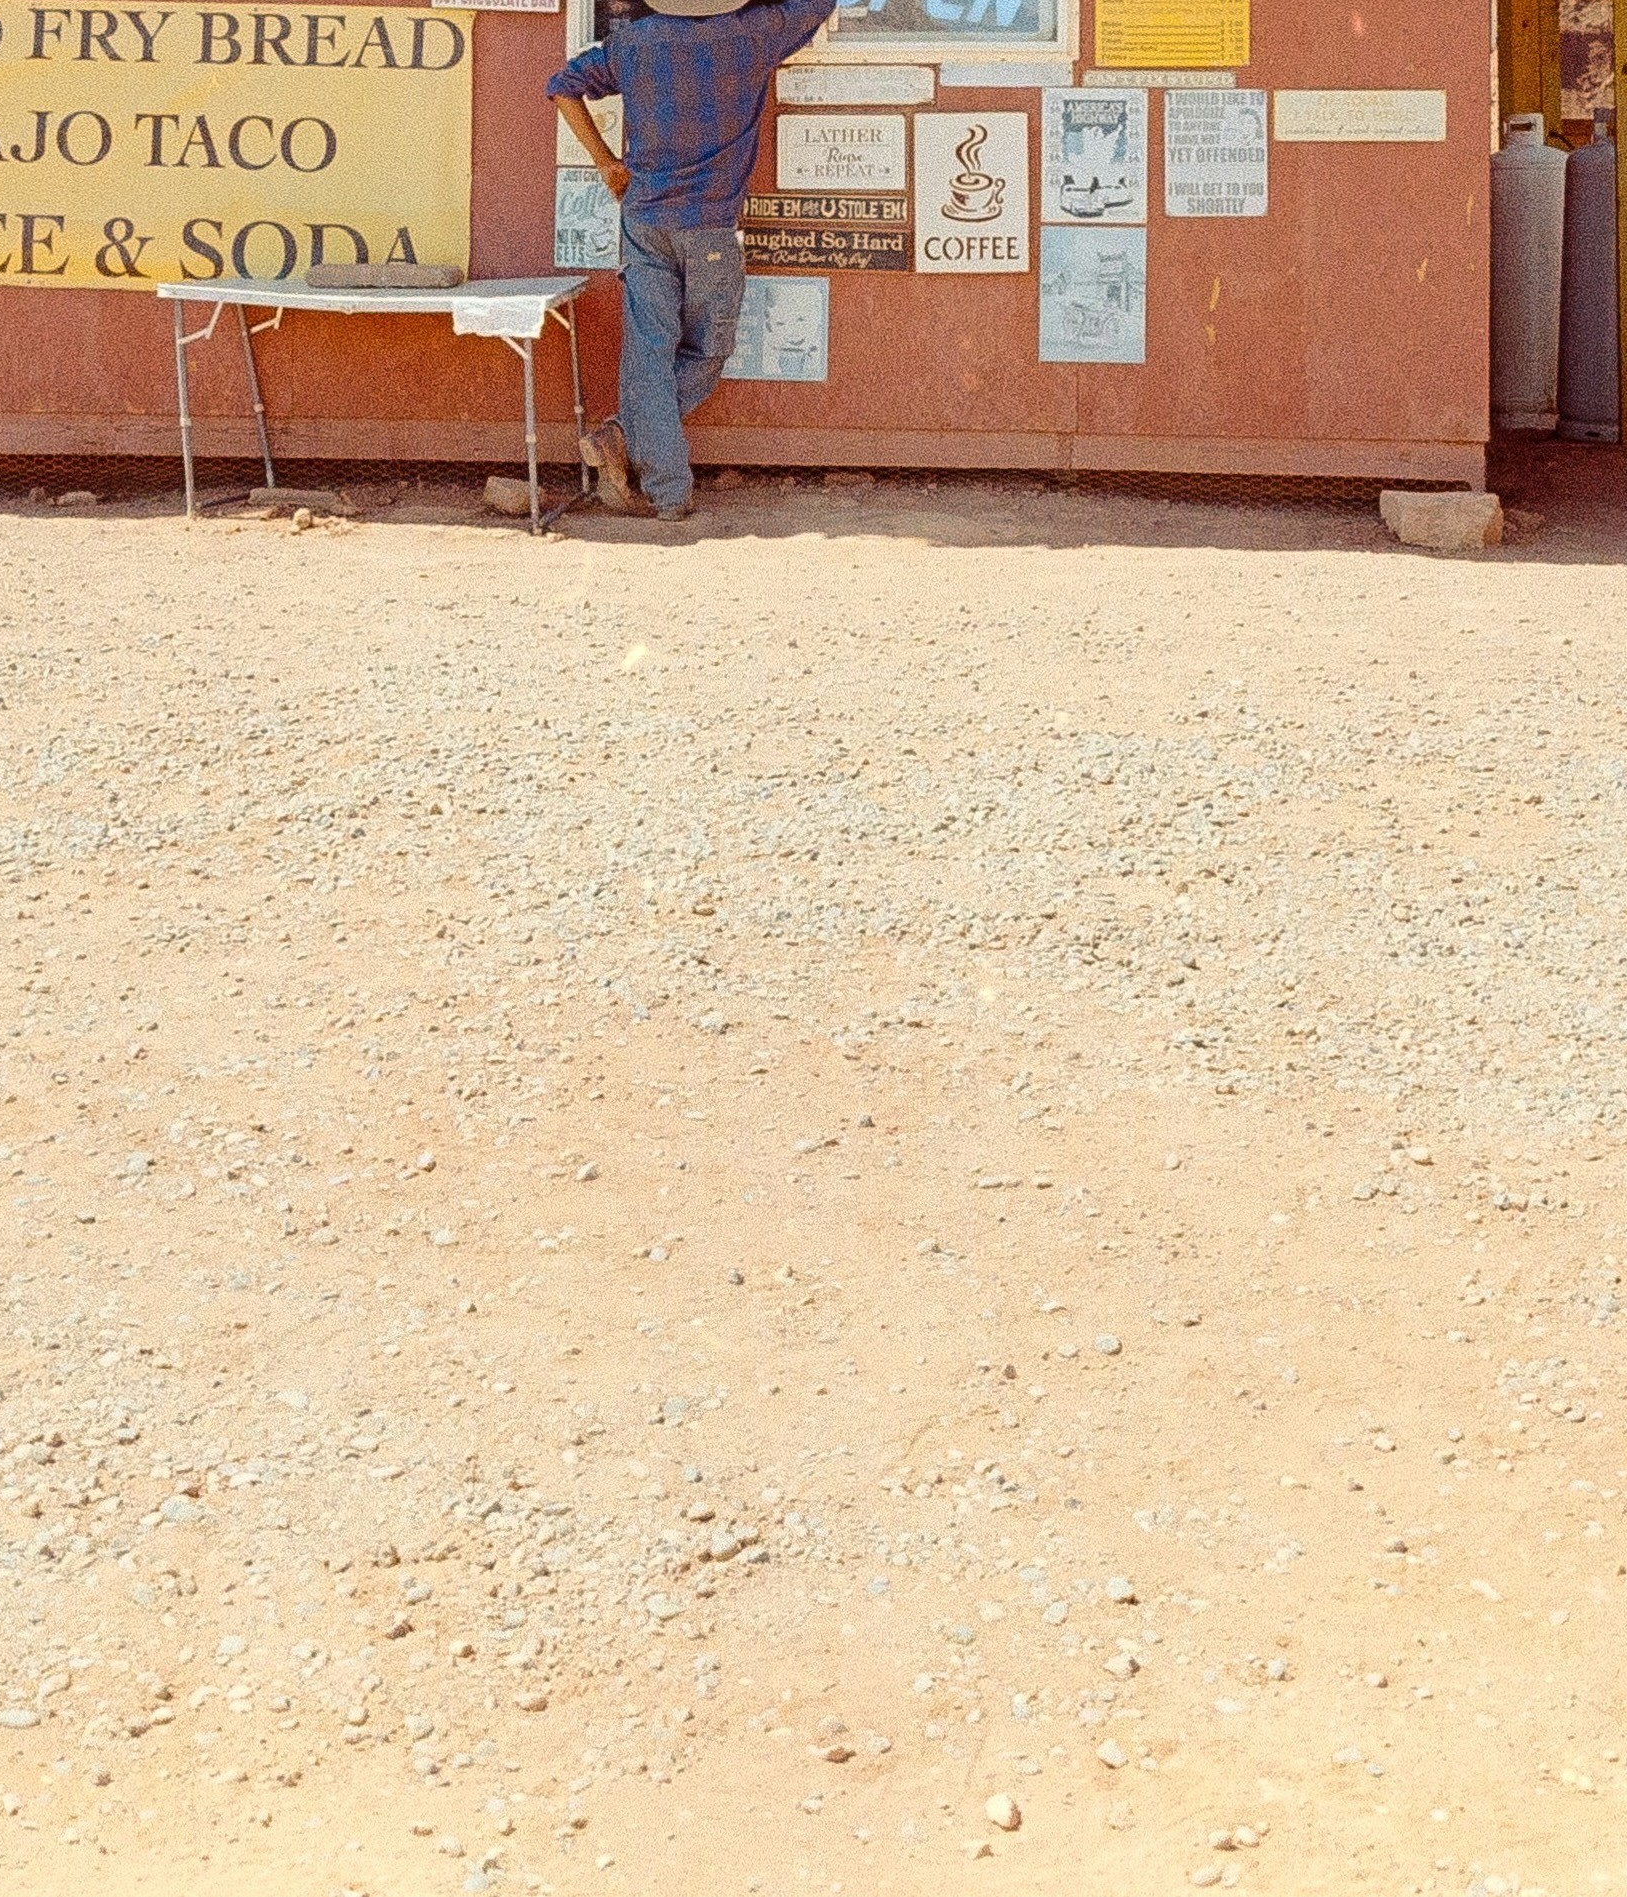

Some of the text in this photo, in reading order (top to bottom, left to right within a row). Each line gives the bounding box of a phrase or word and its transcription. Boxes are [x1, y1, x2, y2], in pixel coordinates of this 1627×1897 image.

[30, 8, 181, 63] FRY
[194, 11, 468, 71] BREAD
[1175, 93, 1219, 105] WOULD
[1222, 93, 1246, 105] LIKE
[1250, 93, 1264, 105] TO
[1168, 107, 1225, 119] APOLOGIZE
[1183, 121, 1221, 131] ANYONE
[134, 111, 338, 173] TACO
[804, 129, 883, 143] LATHER
[1201, 134, 1221, 144] NOT
[826, 146, 864, 163] Rinse
[1168, 147, 1264, 162] YET OFFENDED
[814, 165, 875, 177] REPEAT
[1174, 183, 1201, 195] WILL
[1203, 183, 1223, 195] GET
[1227, 183, 1240, 195] TO
[1243, 183, 1264, 195] YOU
[750, 199, 779, 216] RIDE
[781, 199, 801, 217] 'EM
[838, 199, 878, 218] STOLE
[881, 200, 902, 219] 'EM
[1187, 198, 1246, 213] SHORTLY
[745, 230, 903, 251] aughed So Hard
[93, 215, 156, 279] &
[180, 218, 421, 282] SODA
[557, 246, 585, 262] GETS
[924, 237, 1019, 260] COFFEE
